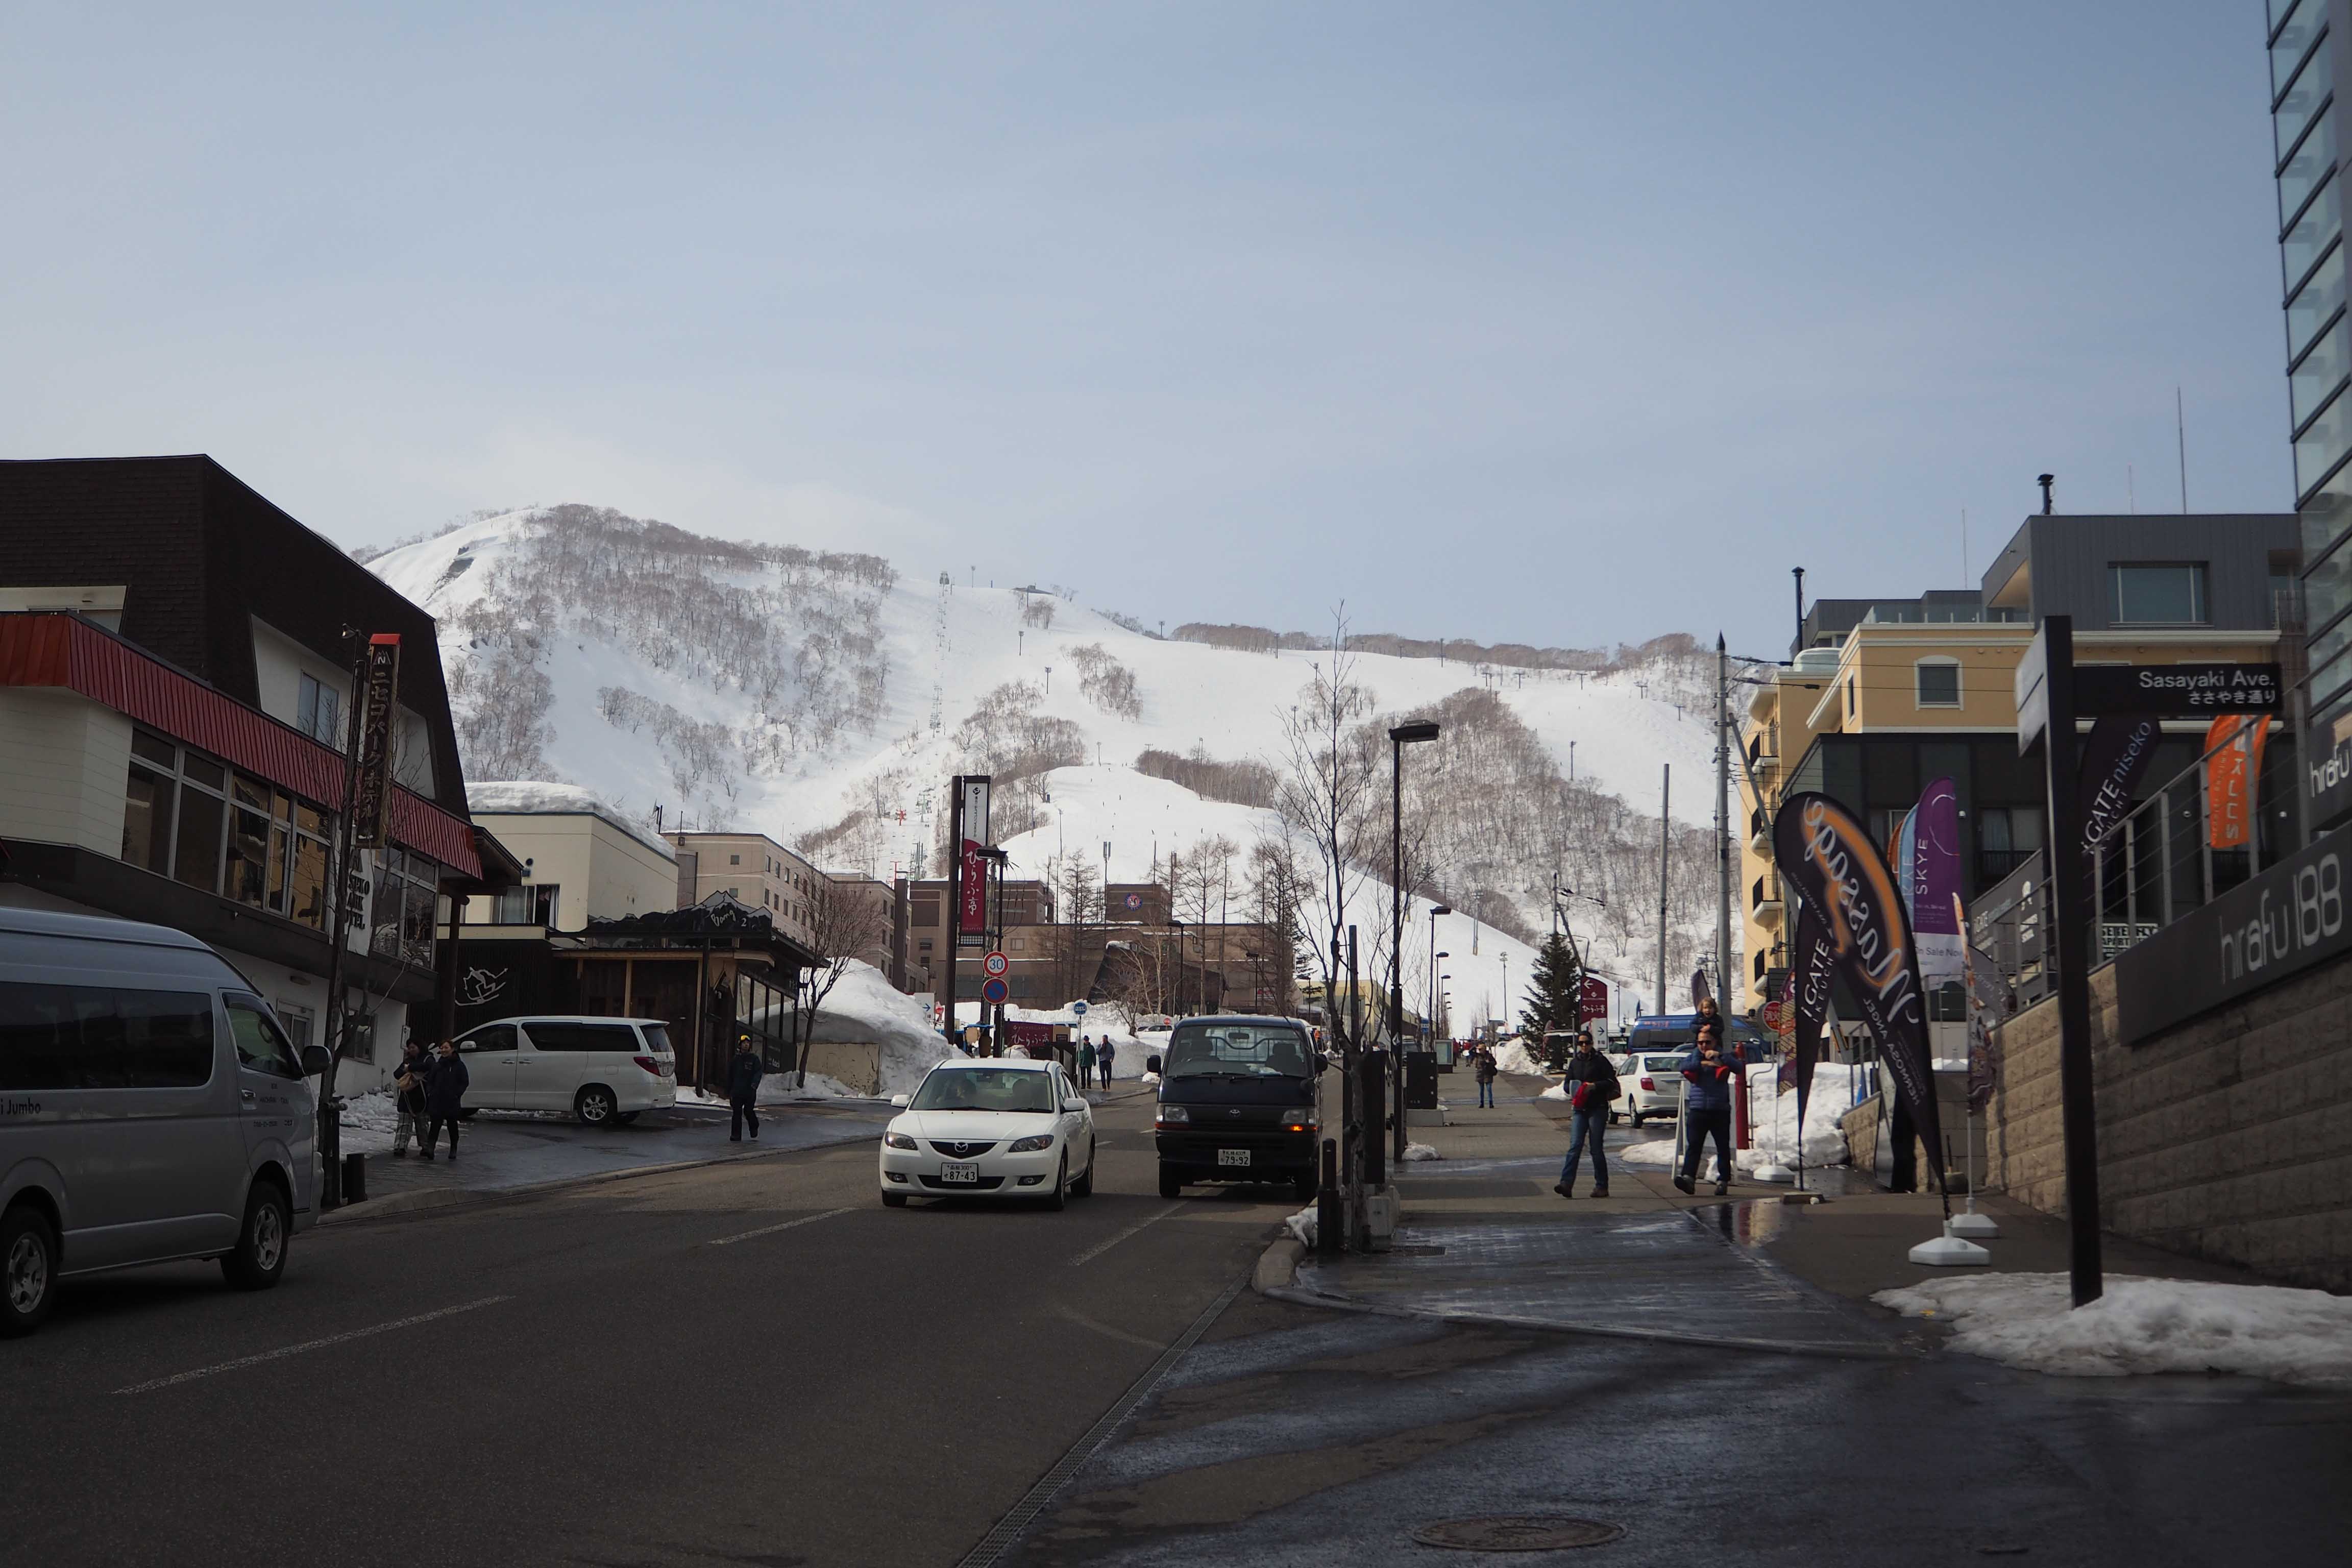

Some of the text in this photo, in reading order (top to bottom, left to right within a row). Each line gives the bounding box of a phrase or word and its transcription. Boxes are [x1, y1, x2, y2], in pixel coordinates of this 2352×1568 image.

[2139, 669, 2274, 690] Sasayaki Ave.
[2189, 690, 2276, 705] ささやき通り
[2113, 722, 2152, 783] niseko
[1915, 838, 1929, 895] SKYE
[965, 849, 983, 916] ひらふ亭
[741, 917, 748, 927] 2
[1926, 947, 1945, 956] Sale
[990, 959, 1003, 970] 30
[1800, 938, 1830, 1018] iGATE
[7, 1097, 41, 1115] Jumbo
[1226, 1156, 1248, 1165] 79-92
[949, 1171, 975, 1181] 87-43
